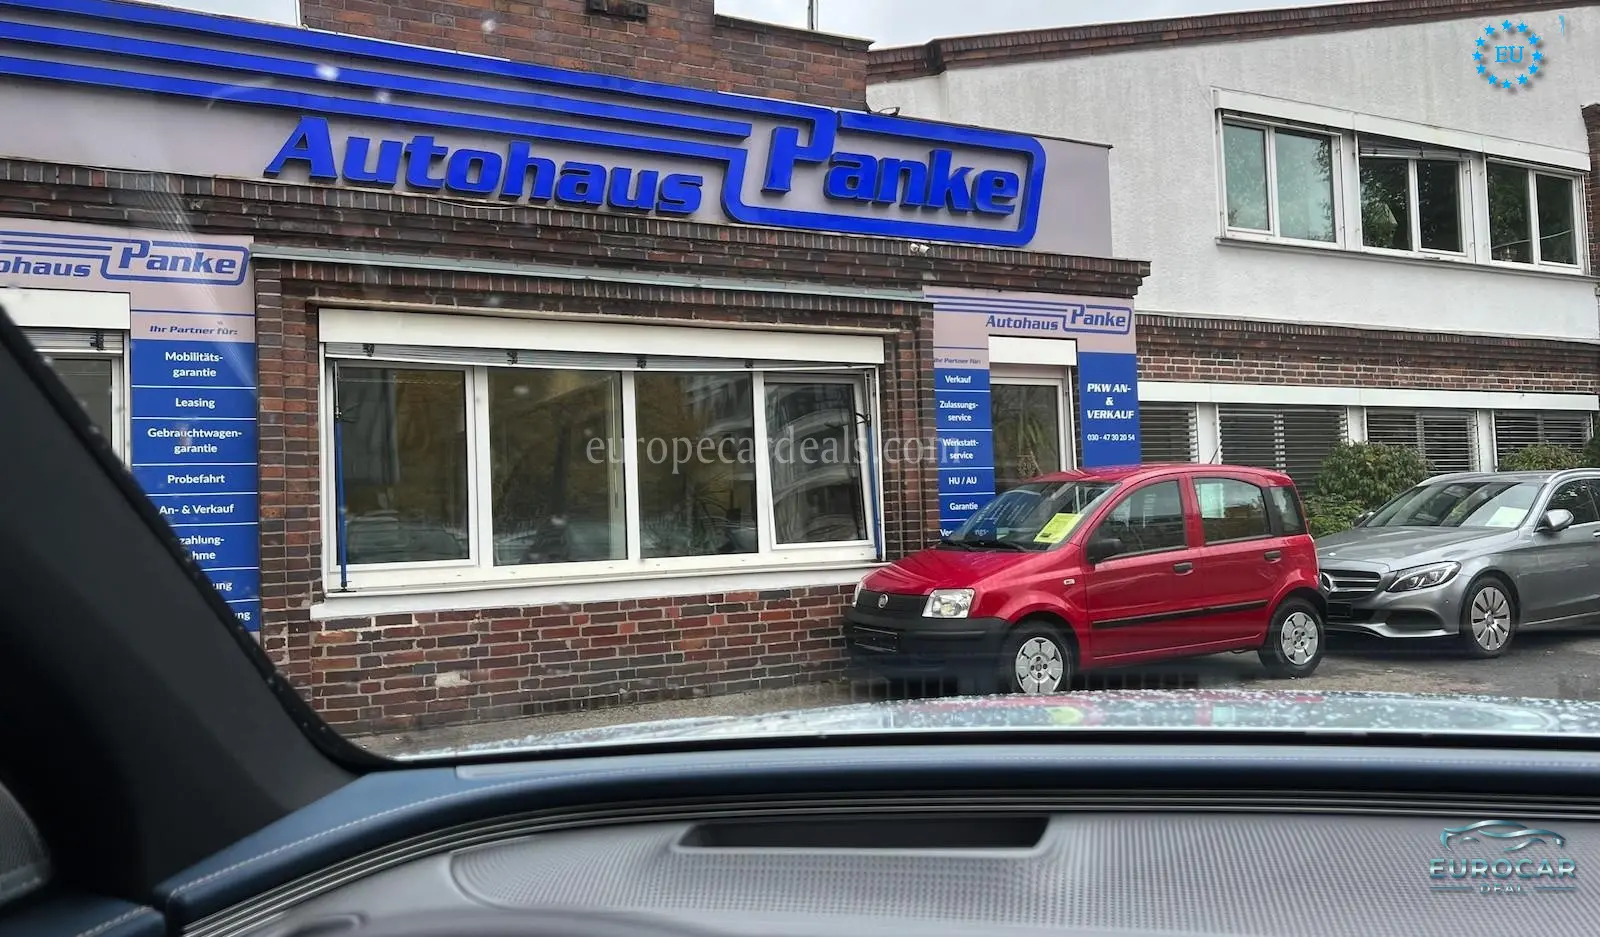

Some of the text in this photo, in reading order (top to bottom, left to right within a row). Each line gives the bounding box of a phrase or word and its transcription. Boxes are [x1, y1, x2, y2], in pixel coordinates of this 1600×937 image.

[264, 108, 1020, 216] Autohaus Panke
[119, 240, 236, 275] Panke
[986, 305, 1126, 331] Autohaus Panke
[149, 325, 239, 337] Ihr Partner für:
[165, 351, 223, 363] Mobilitäts-
[173, 367, 217, 379] garantie
[945, 375, 972, 384] Verkauf
[1087, 383, 1131, 392] PKW AN-
[175, 396, 216, 410] Leasing
[939, 401, 979, 411] Zulassungs-
[1105, 396, 1114, 406] &
[948, 414, 972, 422] service
[1087, 410, 1134, 419] VERKAUF
[147, 427, 243, 441] Gebrauchtwagen-
[1087, 433, 1099, 441] 030
[1103, 433, 1111, 441] 47
[1112, 433, 1119, 441] 30
[1120, 433, 1127, 441] 20
[1128, 433, 1135, 441] 54
[942, 439, 979, 448] Werkstatt-
[173, 443, 218, 456] garantie
[950, 452, 974, 460] service
[167, 473, 225, 485] Probefahrt
[949, 477, 960, 485] HU
[966, 477, 977, 485] AU
[159, 503, 235, 515] An- & Verkauf
[950, 502, 979, 511] Garantie
